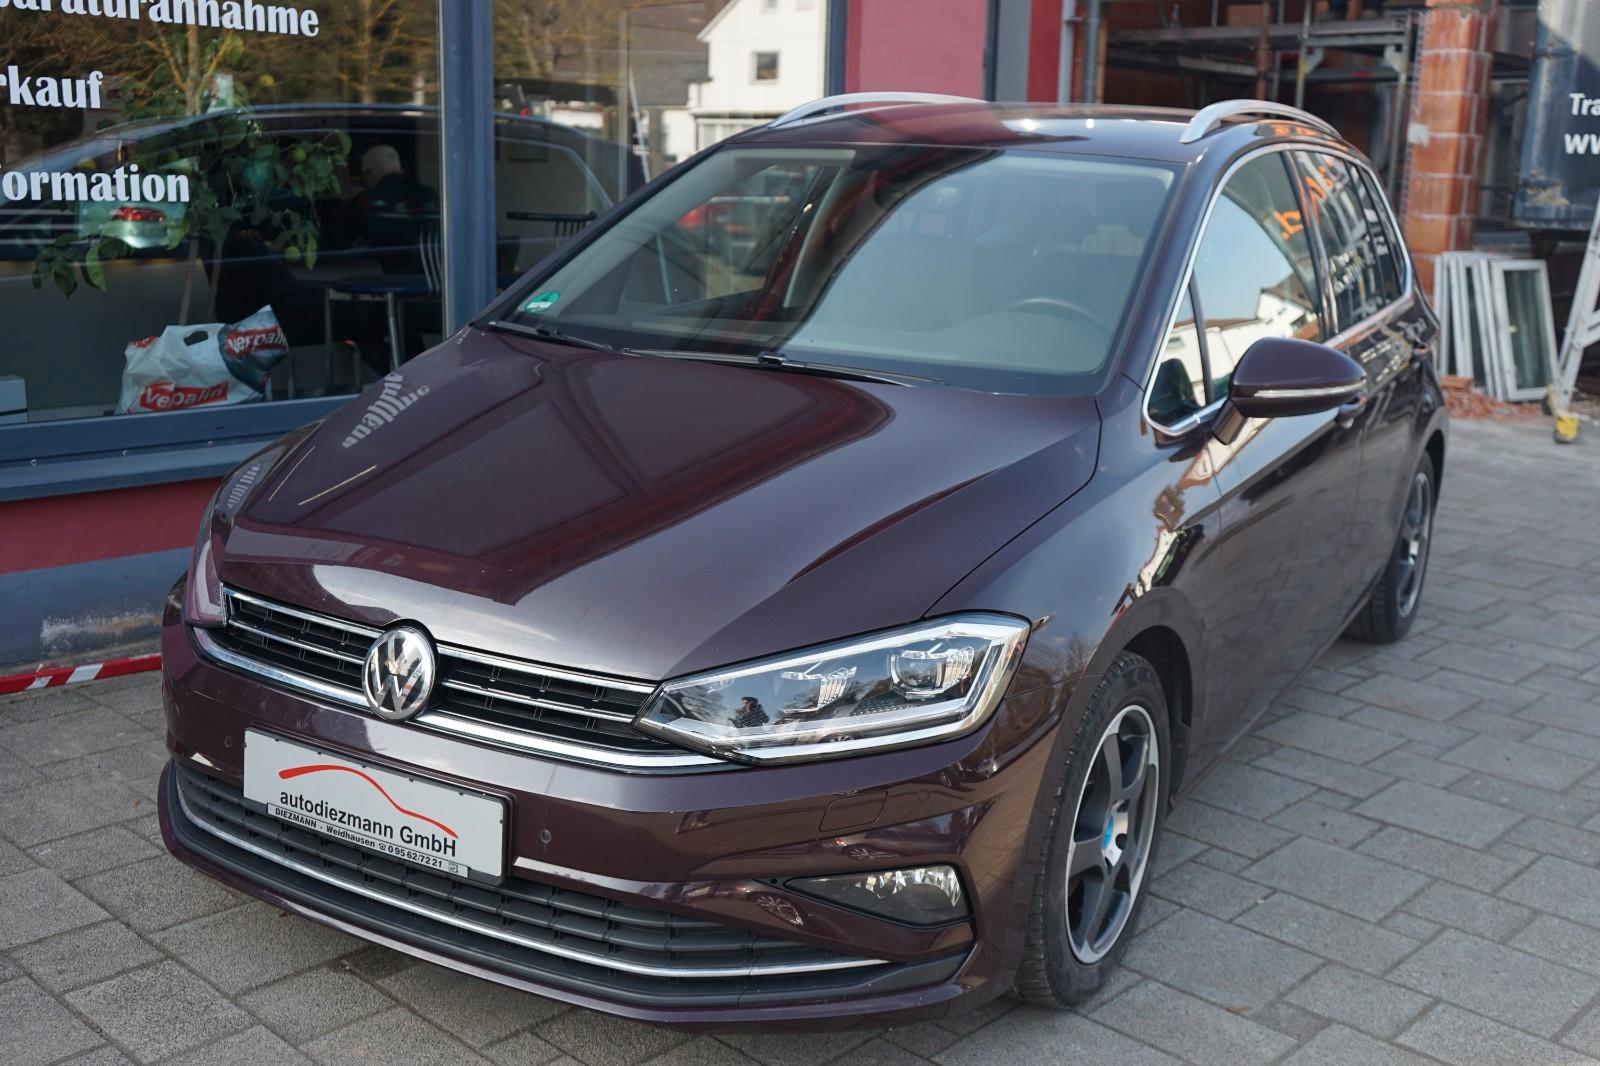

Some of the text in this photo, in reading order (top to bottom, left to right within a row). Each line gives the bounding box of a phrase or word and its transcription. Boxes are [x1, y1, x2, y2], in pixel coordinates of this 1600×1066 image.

[0, 163, 190, 202] ormation
[275, 807, 317, 829] DIEZMANN
[326, 825, 375, 848] Weidhausen
[280, 791, 456, 857] autodiezmann GmbH
